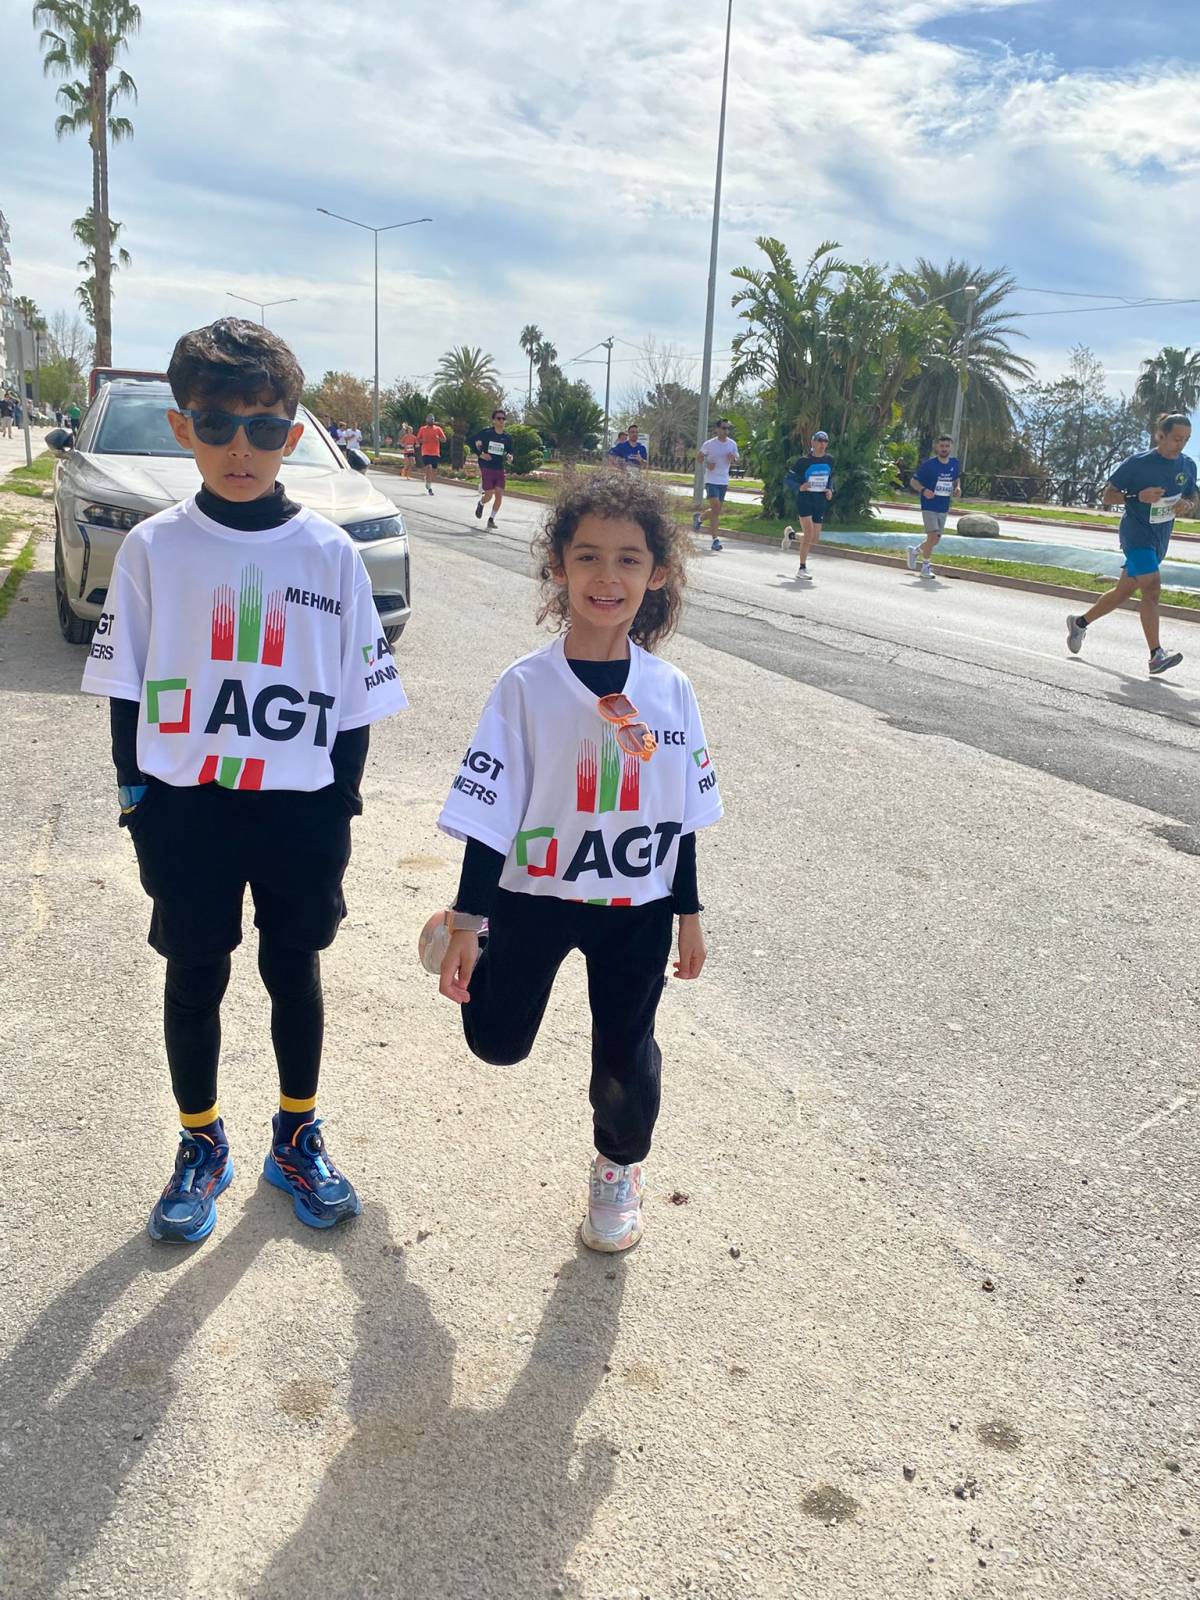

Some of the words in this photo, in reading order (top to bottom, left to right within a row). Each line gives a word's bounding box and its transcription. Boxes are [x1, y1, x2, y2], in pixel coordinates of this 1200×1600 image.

[204, 678, 335, 747] AGT
[664, 730, 686, 746] ECE
[698, 769, 717, 794] RU
[562, 821, 683, 882] AGT
